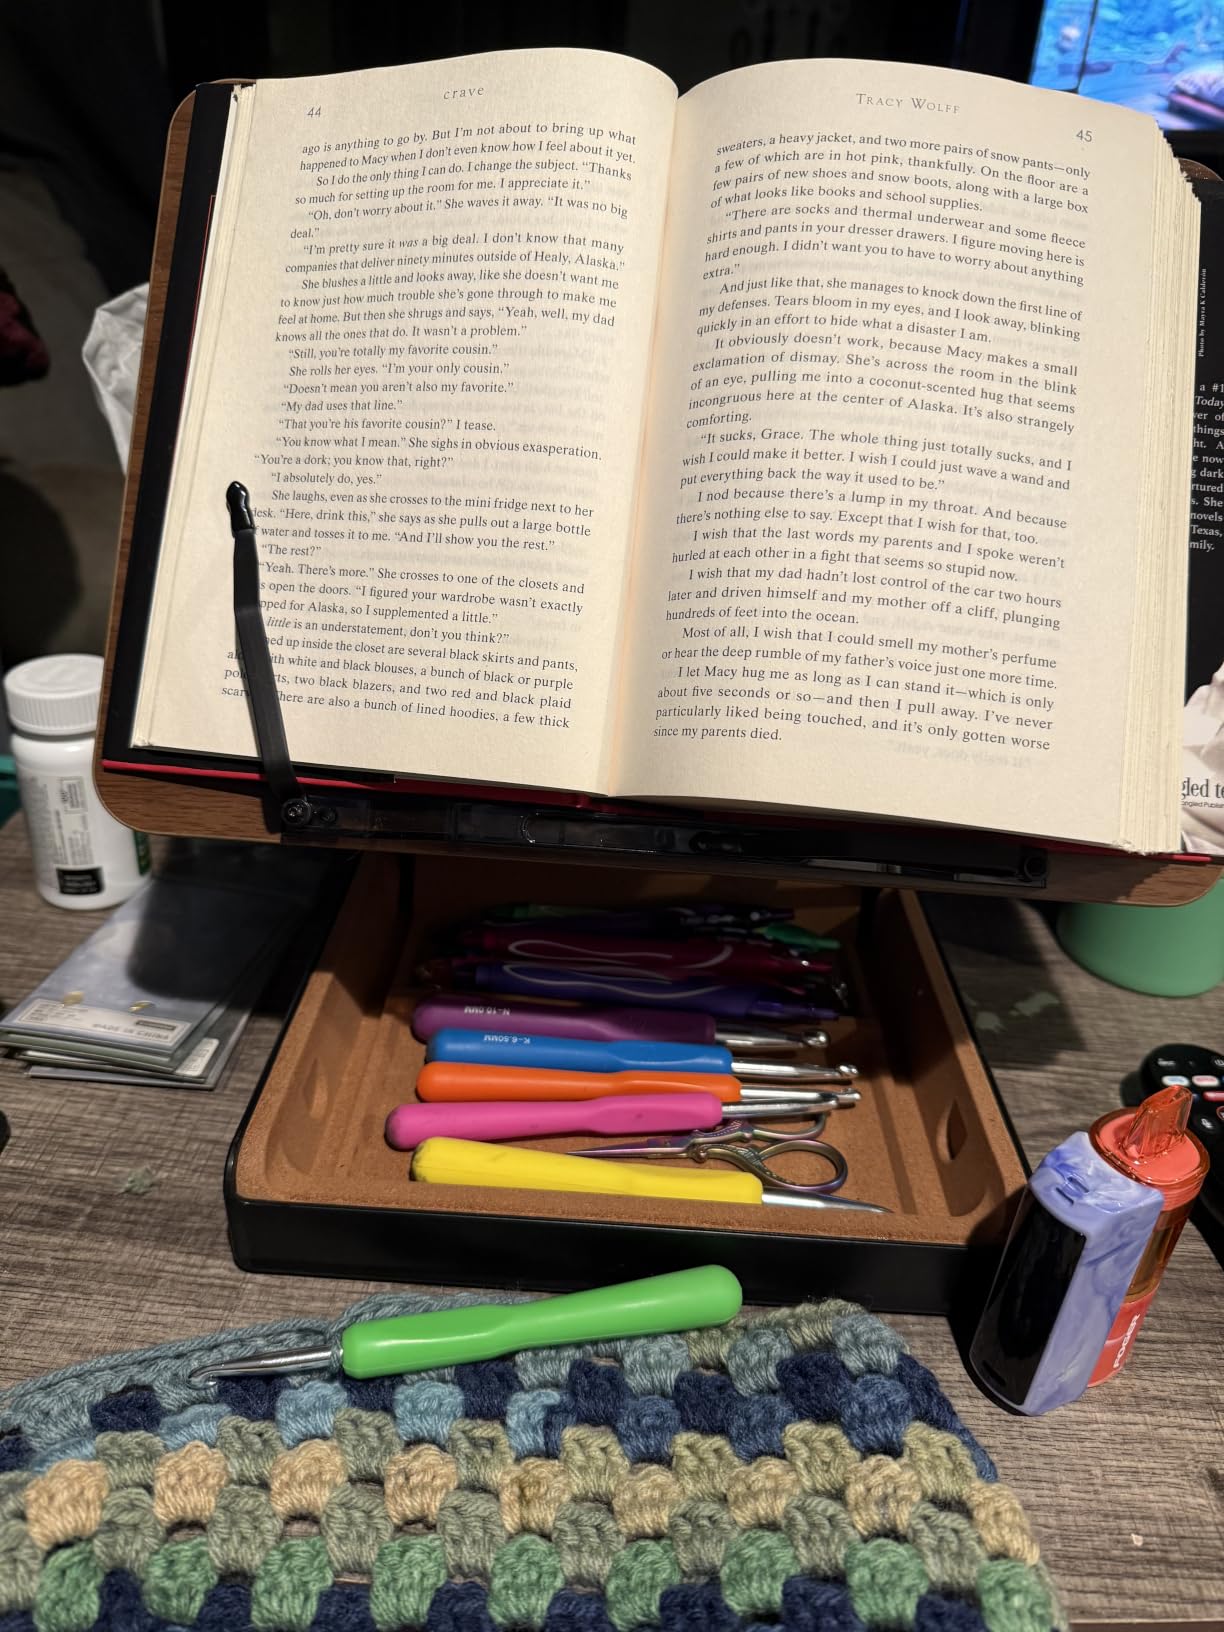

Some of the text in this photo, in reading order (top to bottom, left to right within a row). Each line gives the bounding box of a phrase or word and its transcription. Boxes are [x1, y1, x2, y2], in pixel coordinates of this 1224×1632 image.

[443, 87, 485, 100] crave
[307, 106, 322, 118] 44
[302, 145, 320, 156] ago
[324, 142, 332, 152] is
[335, 138, 380, 152] anything
[383, 137, 394, 146] to
[397, 136, 410, 147] go
[413, 132, 427, 145] by.
[432, 130, 450, 140] But
[476, 126, 495, 136] not
[499, 123, 531, 134] about
[536, 124, 548, 133] to
[552, 122, 584, 137] bring
[589, 127, 604, 139] up
[609, 130, 636, 145] what
[1076, 129, 1092, 142] 45
[716, 138, 766, 156] sweaters,
[779, 134, 814, 145] heavy
[815, 132, 856, 145] jacket,
[859, 135, 881, 145] and
[885, 137, 907, 147] two
[910, 141, 941, 151] more
[944, 143, 973, 156] pairs
[976, 148, 989, 158] of
[990, 152, 1020, 164] snow
[771, 207, 791, 216] are
[795, 203, 830, 214] socks
[834, 205, 858, 216] and
[863, 206, 912, 221] thermal
[917, 213, 985, 230] underwear
[988, 224, 1011, 234] and
[1015, 228, 1047, 241] some
[1051, 232, 1085, 249] fleece
[329, 243, 360, 256] pretty
[362, 242, 384, 251] sure
[388, 239, 395, 249] it
[399, 240, 419, 248] was
[422, 238, 428, 246] a
[432, 235, 448, 248] big
[452, 233, 479, 244] deal.
[484, 233, 488, 244] I
[526, 232, 558, 243] know
[563, 234, 586, 246] that
[591, 240, 624, 255] many
[289, 366, 307, 376] She
[310, 365, 332, 376] rolls
[335, 364, 351, 375] her
[353, 366, 378, 377] eyes.
[408, 365, 434, 376] your
[436, 362, 460, 376] only
[686, 411, 752, 429] comforting.
[304, 436, 332, 447] know
[334, 436, 358, 447] what
[362, 436, 366, 447] I
[408, 437, 428, 448] She
[431, 437, 458, 452] sighs
[461, 438, 472, 449] in
[475, 439, 520, 451] obvious
[522, 444, 601, 460] exasperation.
[680, 474, 697, 489] put
[700, 468, 763, 484] everything
[767, 467, 796, 479] back
[802, 468, 822, 480] the
[826, 472, 851, 485] way
[855, 471, 863, 483] it
[868, 474, 898, 486] used
[902, 477, 915, 487] to
[1200, 467, 1224, 478] dark
[1203, 497, 1223, 507] She
[1191, 512, 1223, 522] novels
[1191, 525, 1223, 537] Texas,
[672, 546, 1017, 582] hurled at each other in a fight that seems so stupid now.
[666, 606, 859, 624] hundreds of feet into the ocean.
[267, 617, 291, 628] little
[294, 618, 302, 629] is
[305, 622, 318, 630] an
[321, 622, 406, 637] understatement,
[441, 631, 462, 642] you
[657, 687, 687, 698] about
[692, 685, 713, 697] five
[718, 687, 770, 699] seconds
[776, 691, 791, 700] or
[859, 695, 889, 709] then
[897, 699, 902, 710] I
[908, 702, 935, 715] pull
[941, 707, 978, 722] away.
[1016, 717, 1053, 730] never
[654, 726, 782, 740] since my parents died.
